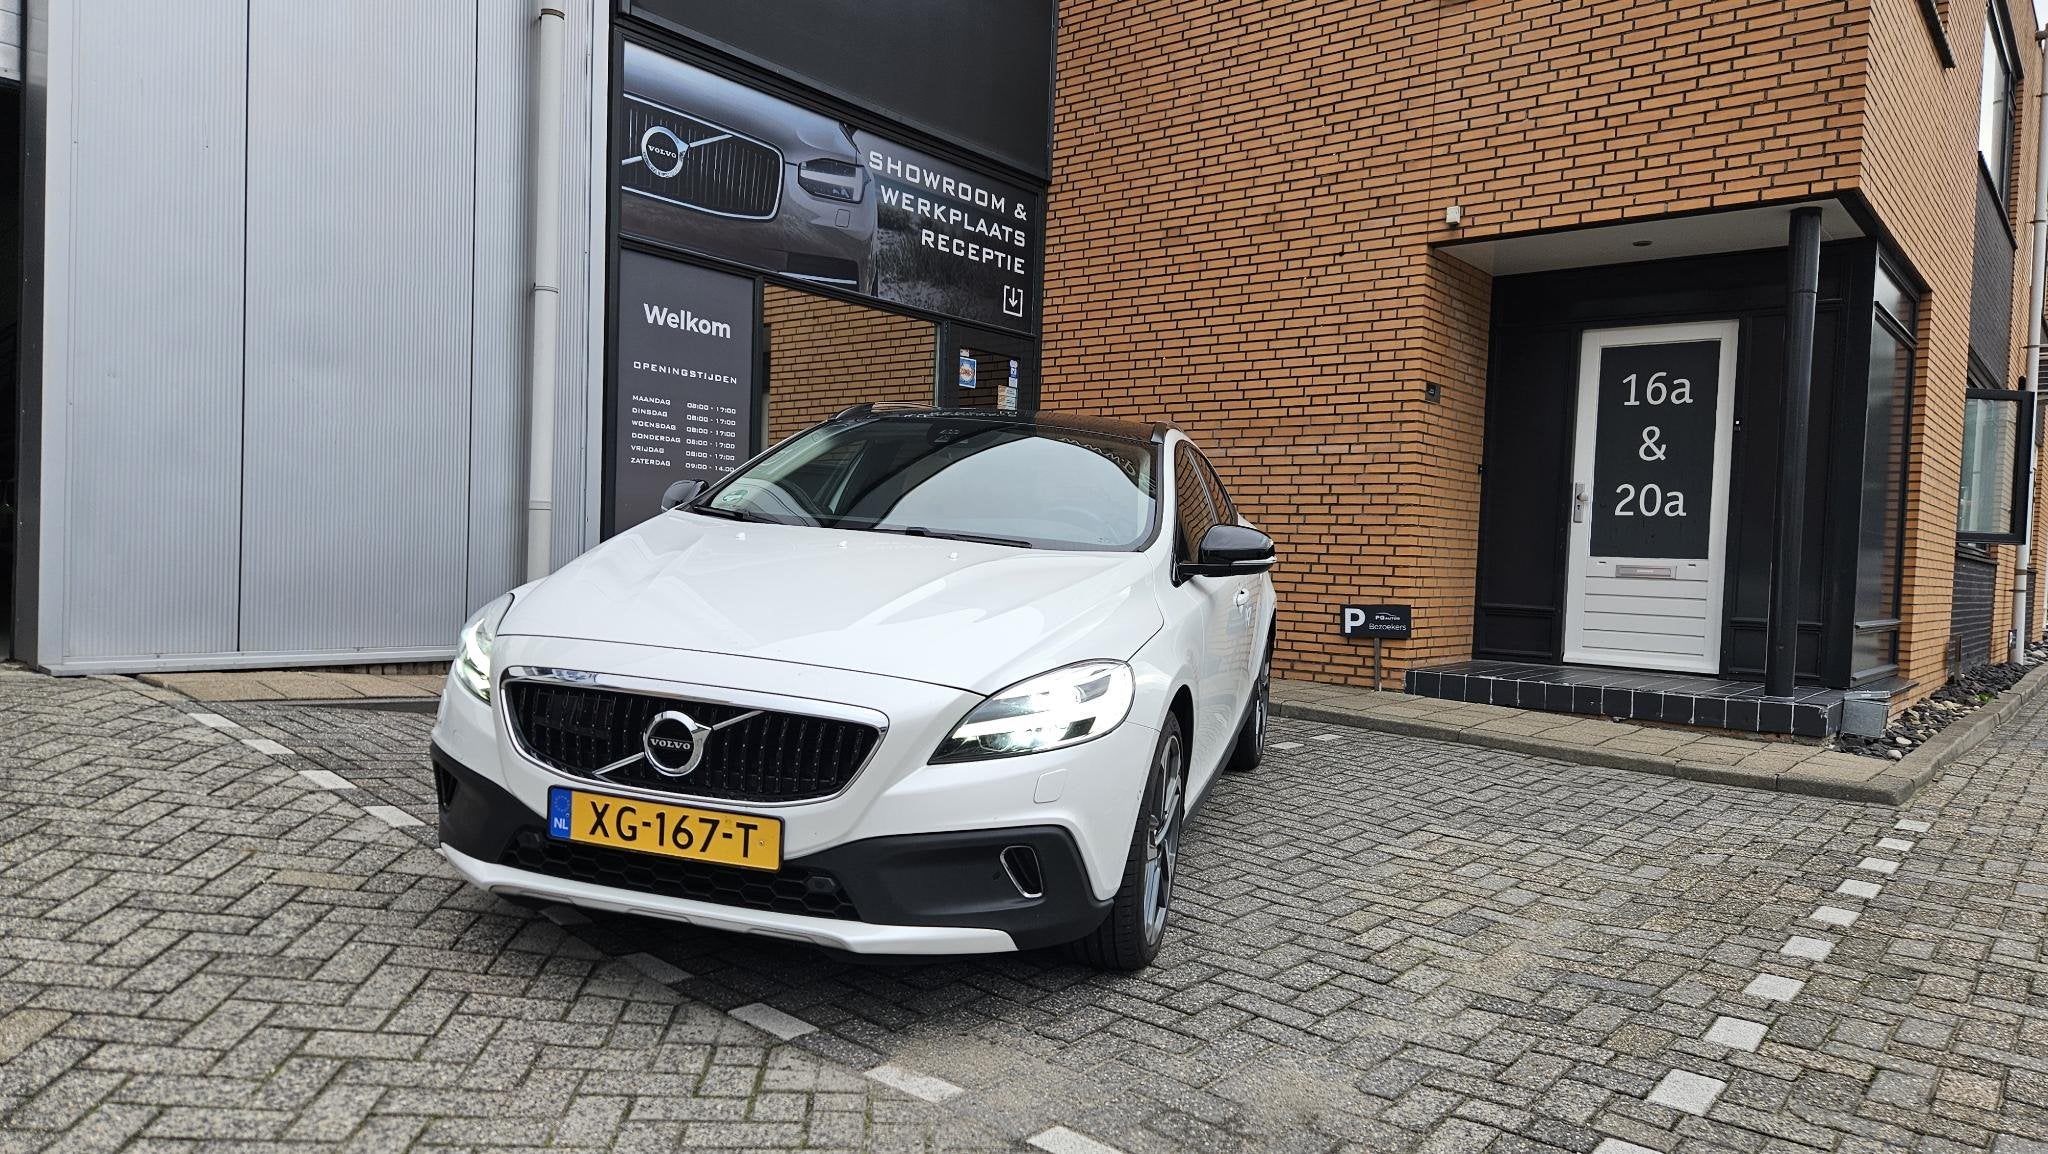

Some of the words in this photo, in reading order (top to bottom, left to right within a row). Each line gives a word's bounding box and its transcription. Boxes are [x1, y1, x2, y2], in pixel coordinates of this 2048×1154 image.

[647, 144, 677, 159] VOLVO
[868, 150, 1005, 213] SHOWROOM
[1013, 203, 1027, 221] &
[880, 184, 1025, 247] WERKPLAATS
[921, 228, 1025, 274] RECEPTIE
[643, 302, 731, 339] Welkom
[633, 361, 737, 385] OPENINGSTIJDEN
[1622, 371, 1694, 406] 16a
[632, 395, 671, 406] MAANDAG
[687, 402, 709, 411] 08:00
[716, 406, 736, 415] 17:00
[632, 407, 668, 417] DINSDAG
[686, 414, 708, 423] 08:00
[716, 418, 736, 426] 17:00
[631, 419, 676, 430] WOENSDAG
[686, 426, 708, 434] 08:00
[715, 430, 736, 438] 17:00
[631, 432, 681, 443] DONDERDAG
[686, 438, 708, 446] 08:00
[715, 441, 735, 449] 17:00
[630, 444, 665, 454] VRIJDAG
[685, 450, 708, 458] 08:00
[714, 453, 735, 461] 17:00
[1638, 425, 1667, 462] &
[630, 457, 671, 467] ZATERDAG
[685, 462, 708, 470] 09:00
[1614, 483, 1687, 517] 20a
[1344, 607, 1366, 634] P
[1368, 622, 1407, 631] Bezoekers
[650, 738, 691, 750] VOLVO
[553, 818, 569, 830] NL
[588, 801, 758, 858] XG-167-T
